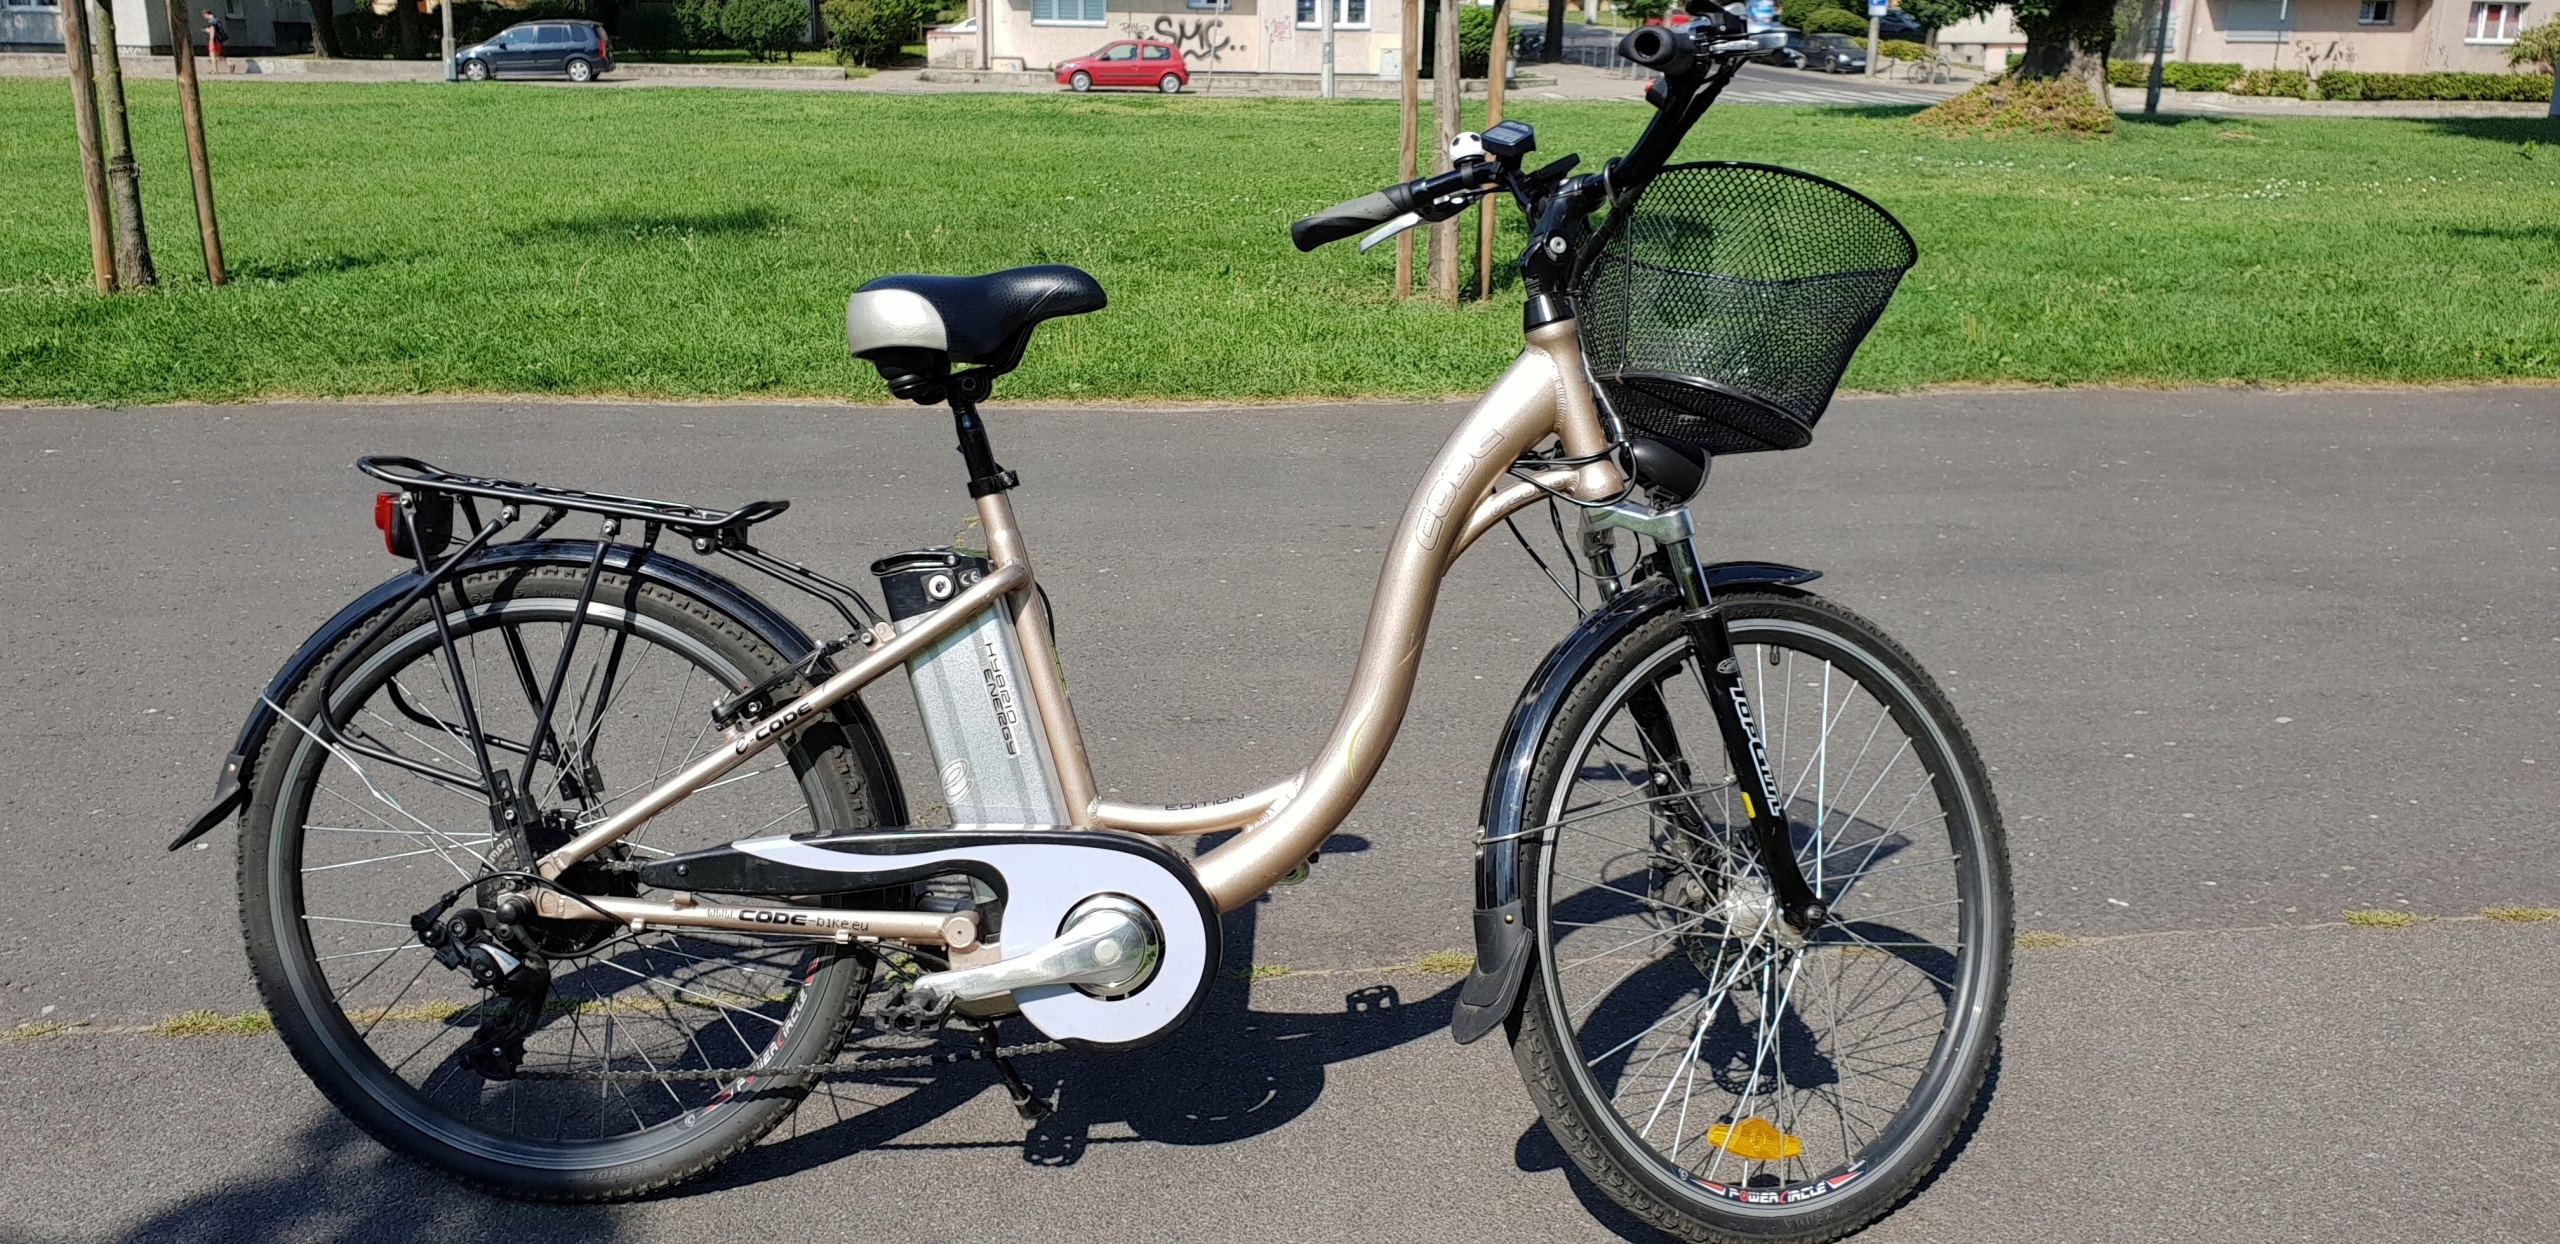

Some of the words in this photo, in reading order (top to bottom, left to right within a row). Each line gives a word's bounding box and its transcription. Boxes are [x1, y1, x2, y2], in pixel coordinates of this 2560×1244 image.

[961, 571, 980, 585] CE
[985, 643, 1017, 724] HYBRID
[983, 669, 1017, 755] ENERGY
[735, 701, 813, 755] e-CODE
[1165, 793, 1245, 811] EDITION
[586, 1164, 643, 1181] KENDA
[1729, 1182, 1827, 1204] POWERCIRCLE
